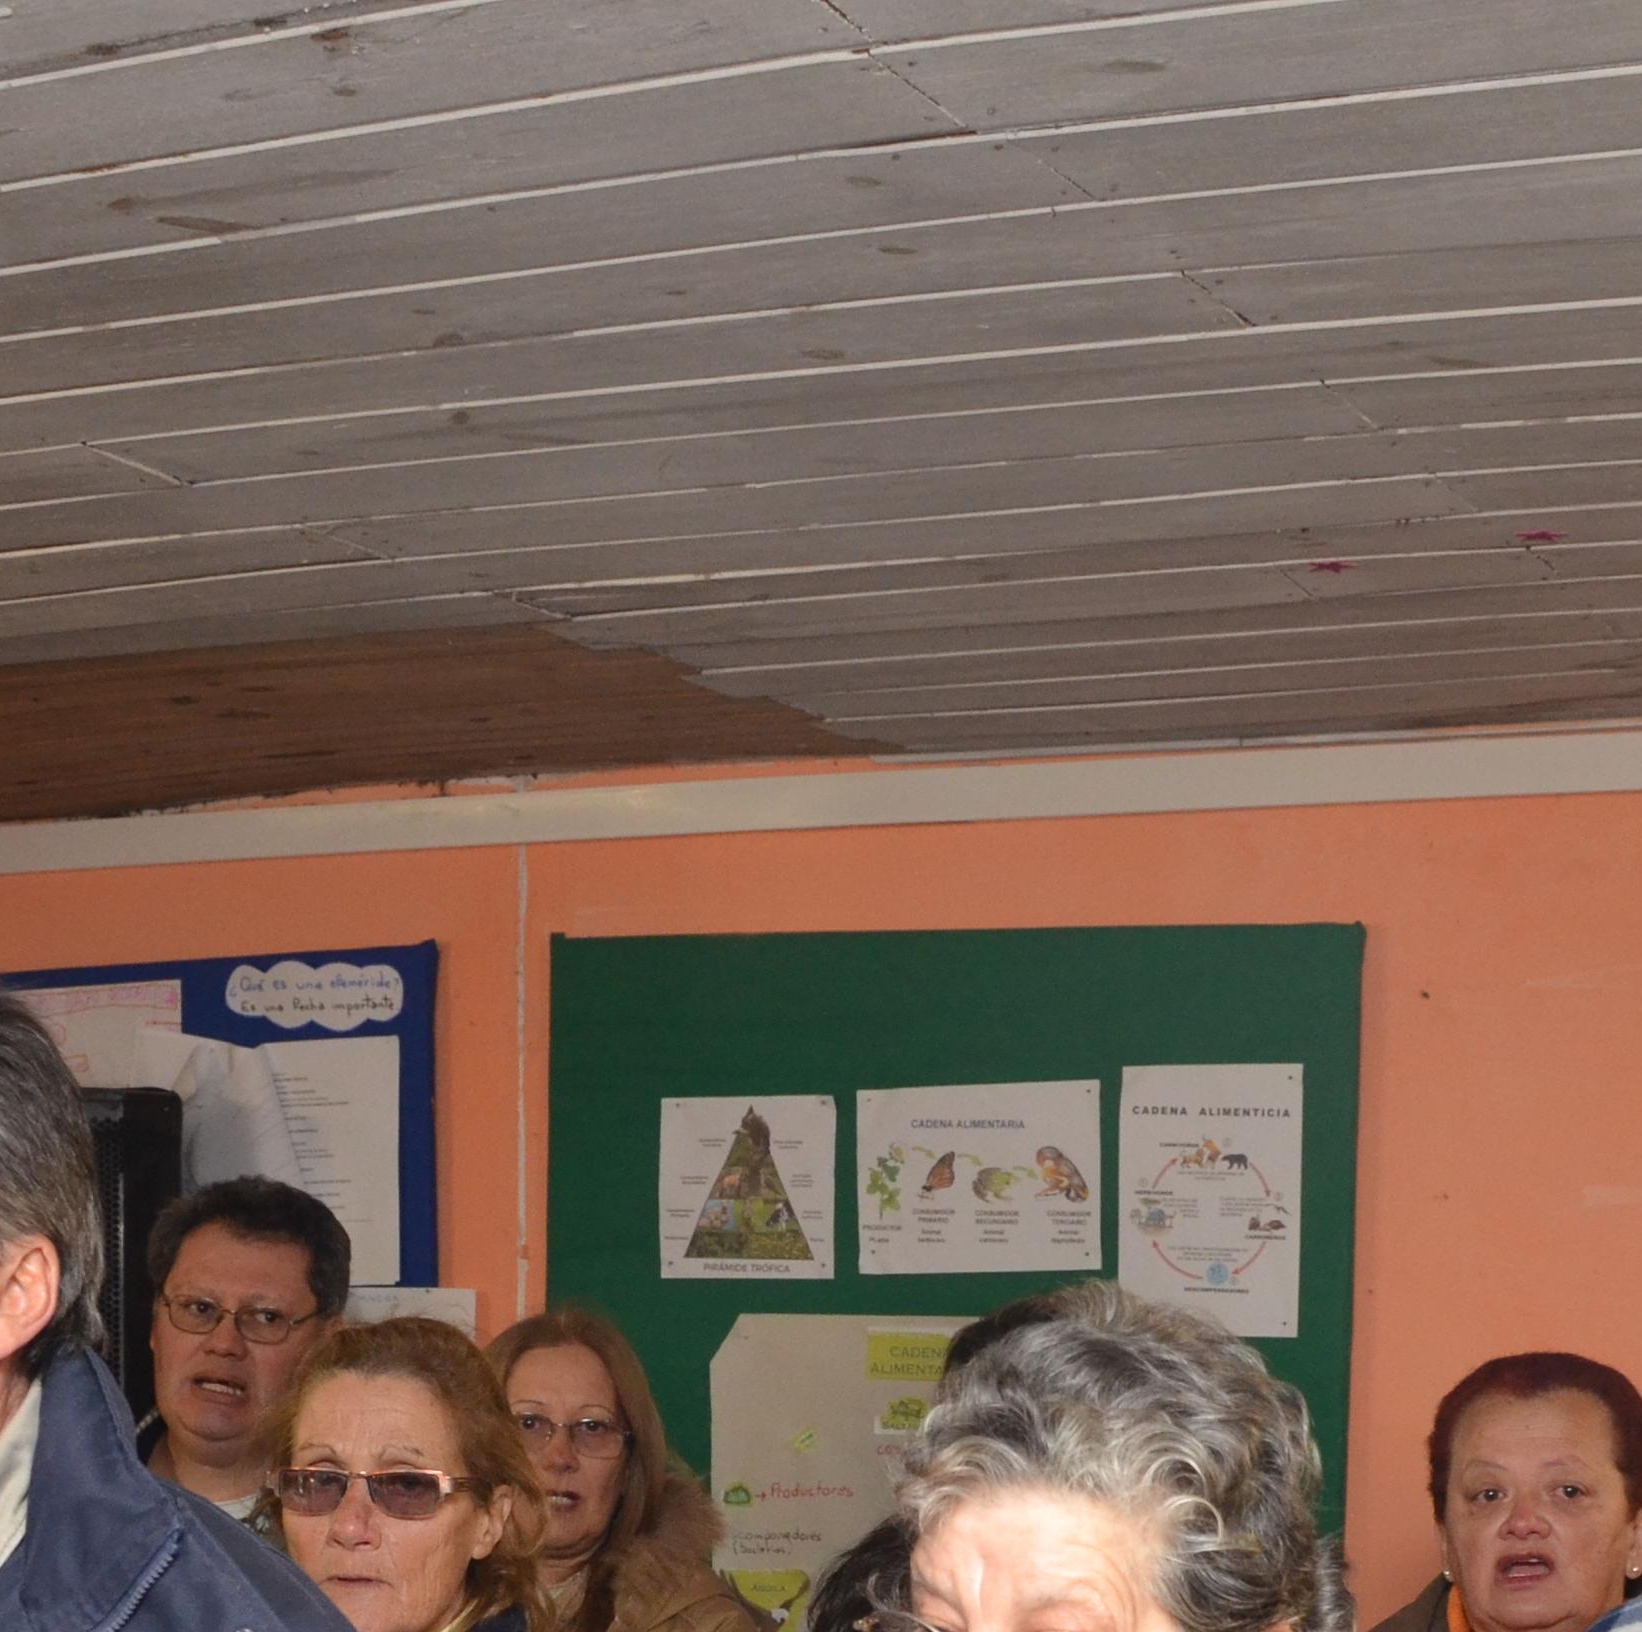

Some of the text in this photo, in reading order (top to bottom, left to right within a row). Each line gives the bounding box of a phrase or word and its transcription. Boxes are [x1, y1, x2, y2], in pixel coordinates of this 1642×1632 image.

[296, 979, 323, 991] una
[331, 994, 395, 1017] importante
[1132, 1105, 1291, 1118] CADENA ALIMENTICIA
[910, 1119, 1026, 1130] CADENA ALIMENTARIA
